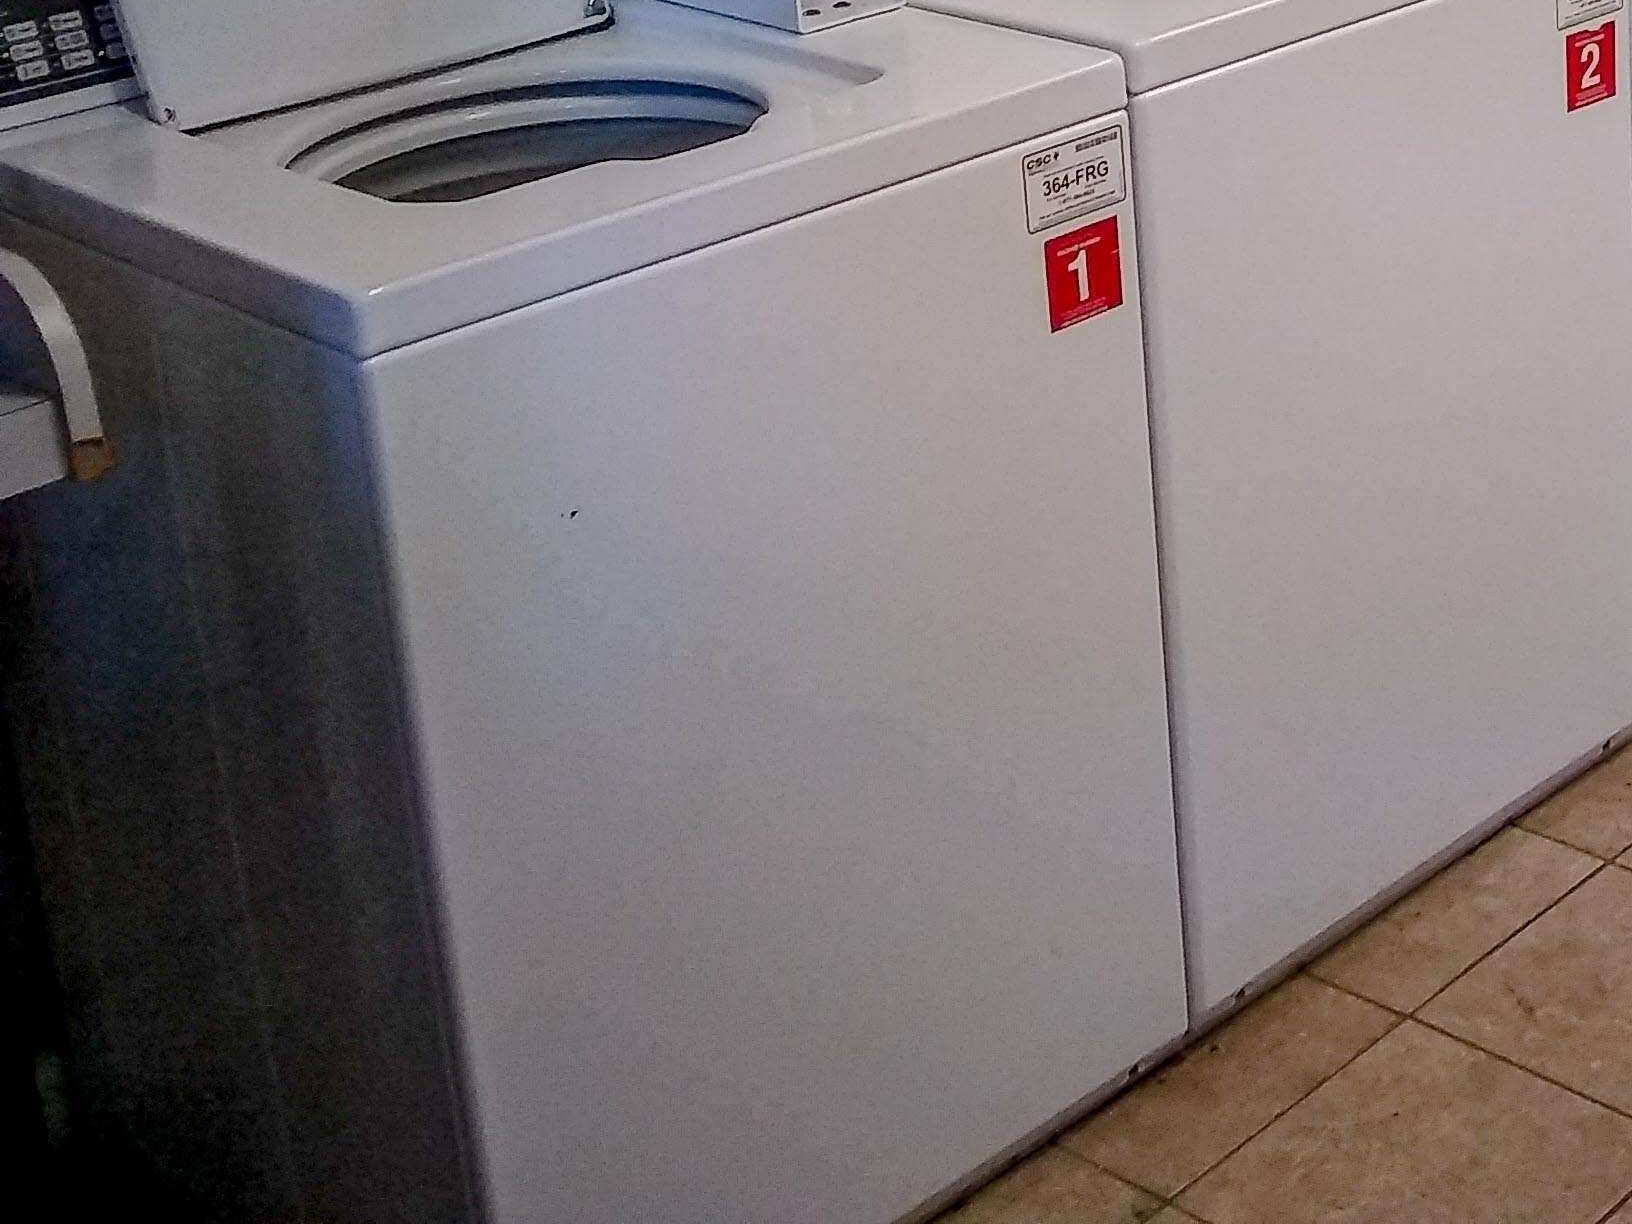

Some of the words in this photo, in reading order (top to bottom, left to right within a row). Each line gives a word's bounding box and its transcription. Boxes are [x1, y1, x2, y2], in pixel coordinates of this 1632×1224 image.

[1580, 42, 1601, 90] 2
[1026, 153, 1052, 170] CSC
[1042, 160, 1110, 197] 364-FRG
[1067, 248, 1090, 303] 1
